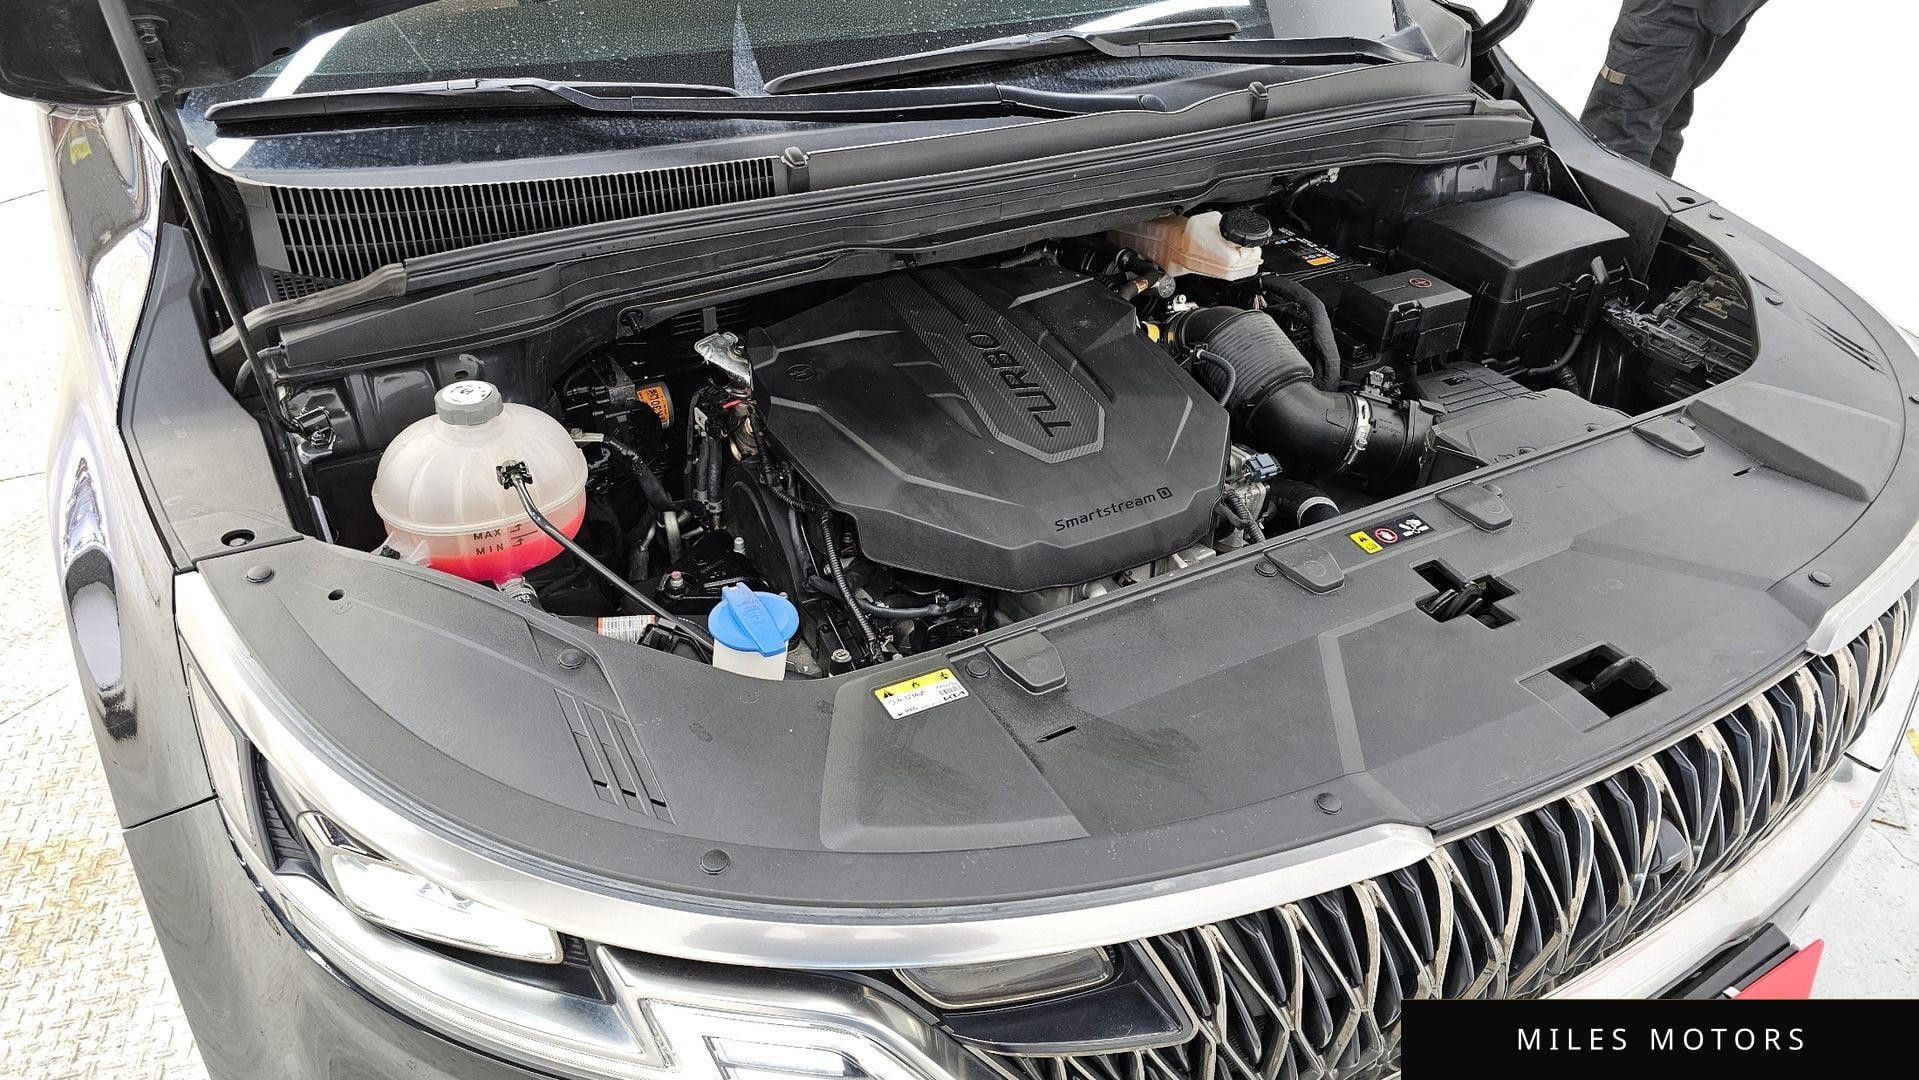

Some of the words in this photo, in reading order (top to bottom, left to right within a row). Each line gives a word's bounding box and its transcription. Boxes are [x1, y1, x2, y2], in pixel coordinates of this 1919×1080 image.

[965, 331, 1072, 438] TURBO
[1054, 494, 1157, 532] Smartstream
[473, 529, 501, 540] MAX
[475, 543, 504, 555] MIN
